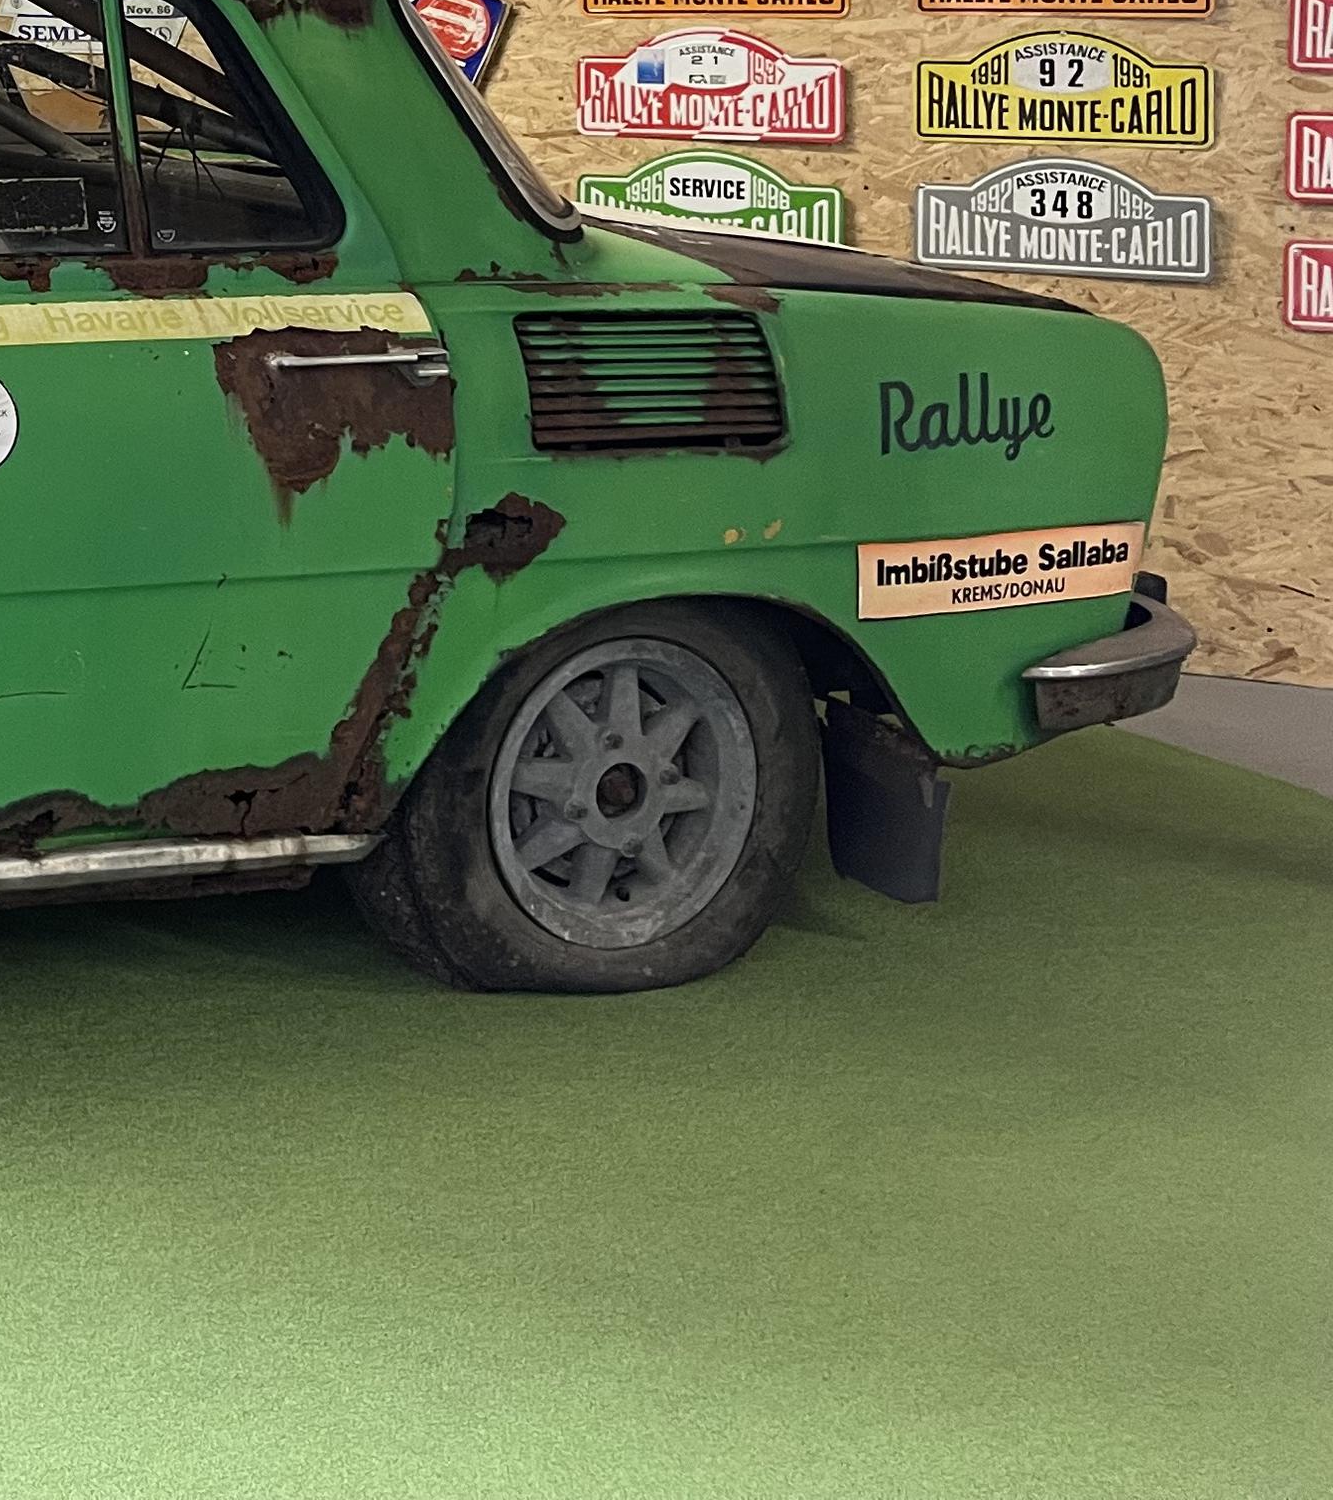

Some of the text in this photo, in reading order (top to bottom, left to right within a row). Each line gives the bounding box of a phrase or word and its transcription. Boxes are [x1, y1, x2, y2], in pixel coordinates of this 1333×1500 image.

[127, 6, 171, 14] Nov. 86
[1014, 43, 1107, 62] ASSISTANCE
[1040, 58, 1084, 88] 92
[669, 176, 745, 200] SERVICE
[1016, 171, 1109, 192] ASSISTANCE
[1031, 190, 1093, 219] 348
[43, 306, 183, 336] Havarie
[222, 300, 404, 328] Vollservice
[879, 372, 1055, 461] Rallye
[877, 538, 1129, 586] Imbißstube Sallaba
[951, 578, 1065, 604] KREMS/DONAU
